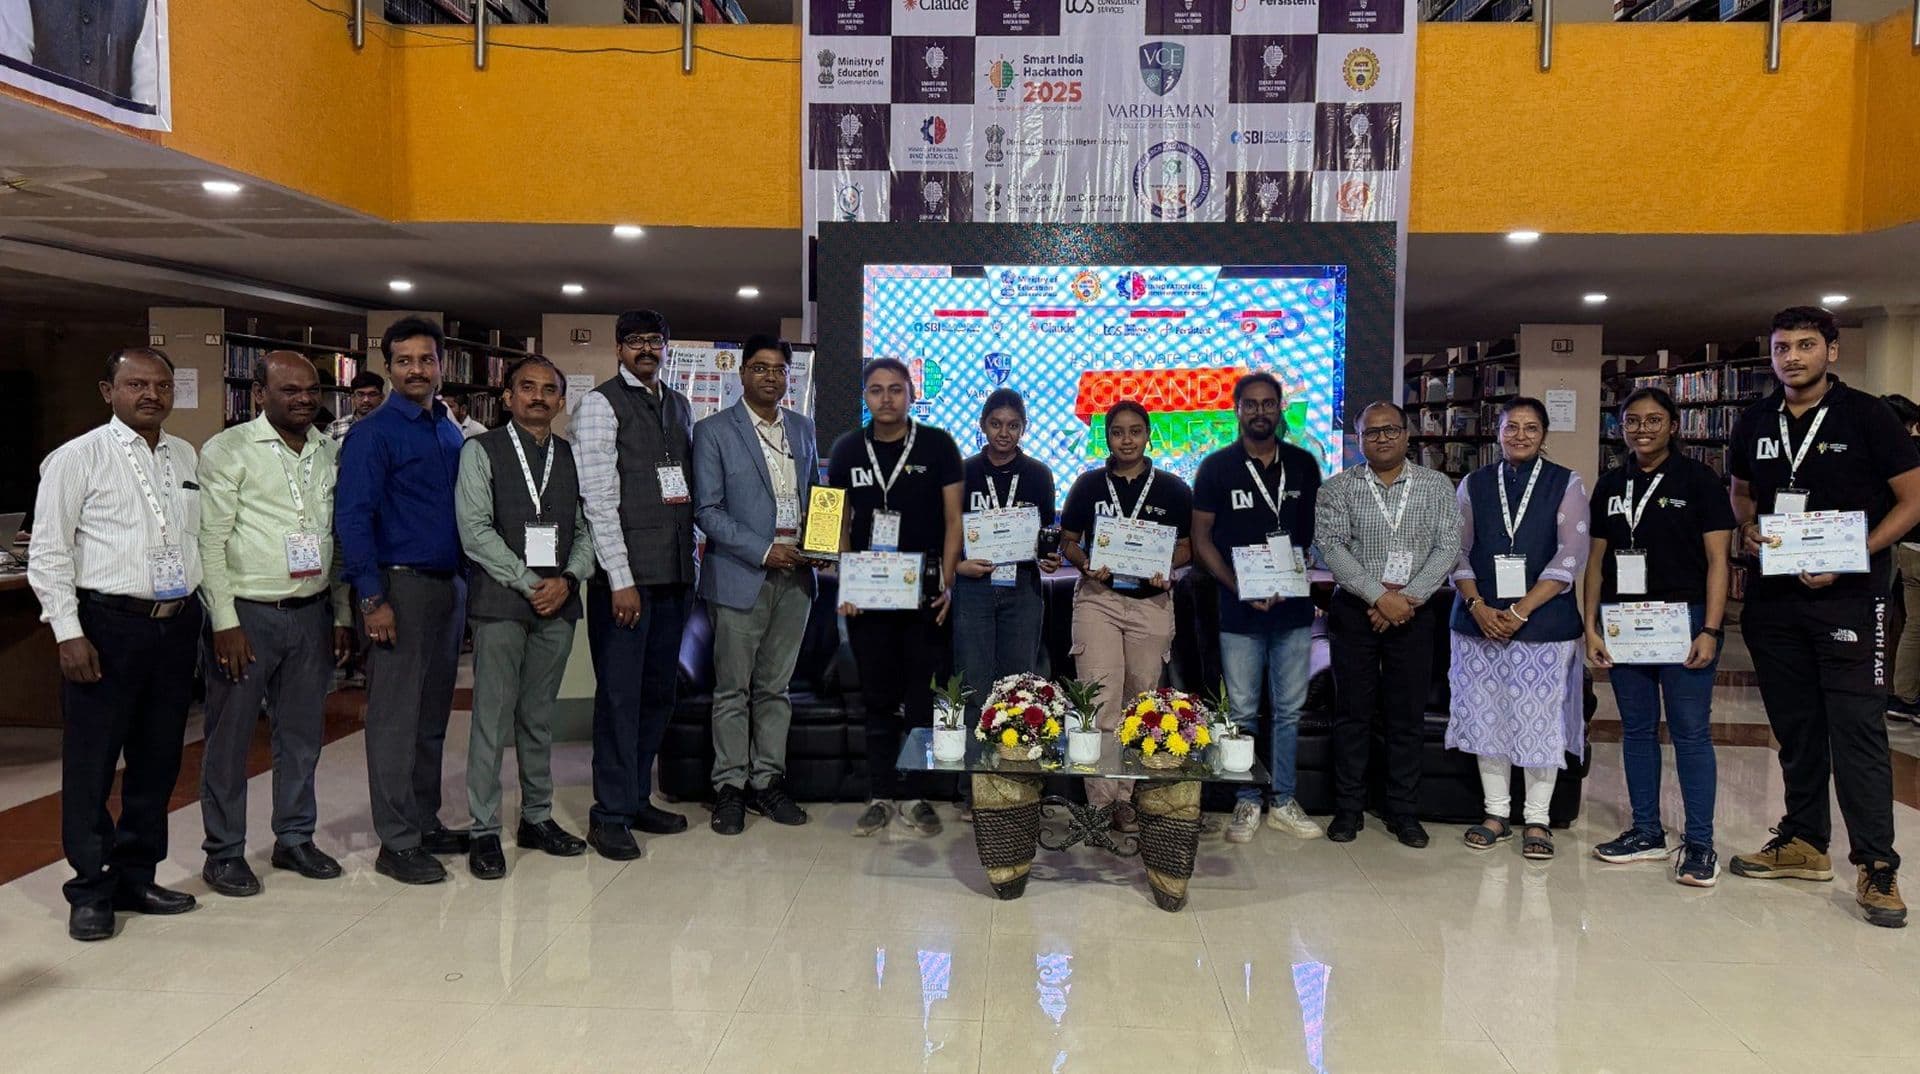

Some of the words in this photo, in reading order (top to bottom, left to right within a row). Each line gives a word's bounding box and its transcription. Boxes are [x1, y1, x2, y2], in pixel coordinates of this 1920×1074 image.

[837, 57, 873, 68] Ministry
[875, 57, 885, 66] of
[1023, 54, 1055, 64] Smart
[1058, 54, 1084, 64] India
[1144, 48, 1182, 66] VCE
[837, 69, 879, 78] Education
[1023, 67, 1083, 77] Hackathon
[1023, 81, 1082, 103] 2025
[1108, 103, 1215, 119] VARDHAMAN
[1243, 131, 1263, 144] SBI
[1090, 375, 1222, 408] GRAND
[1874, 602, 1886, 648] NORTH
[1873, 651, 1885, 686] FACE
